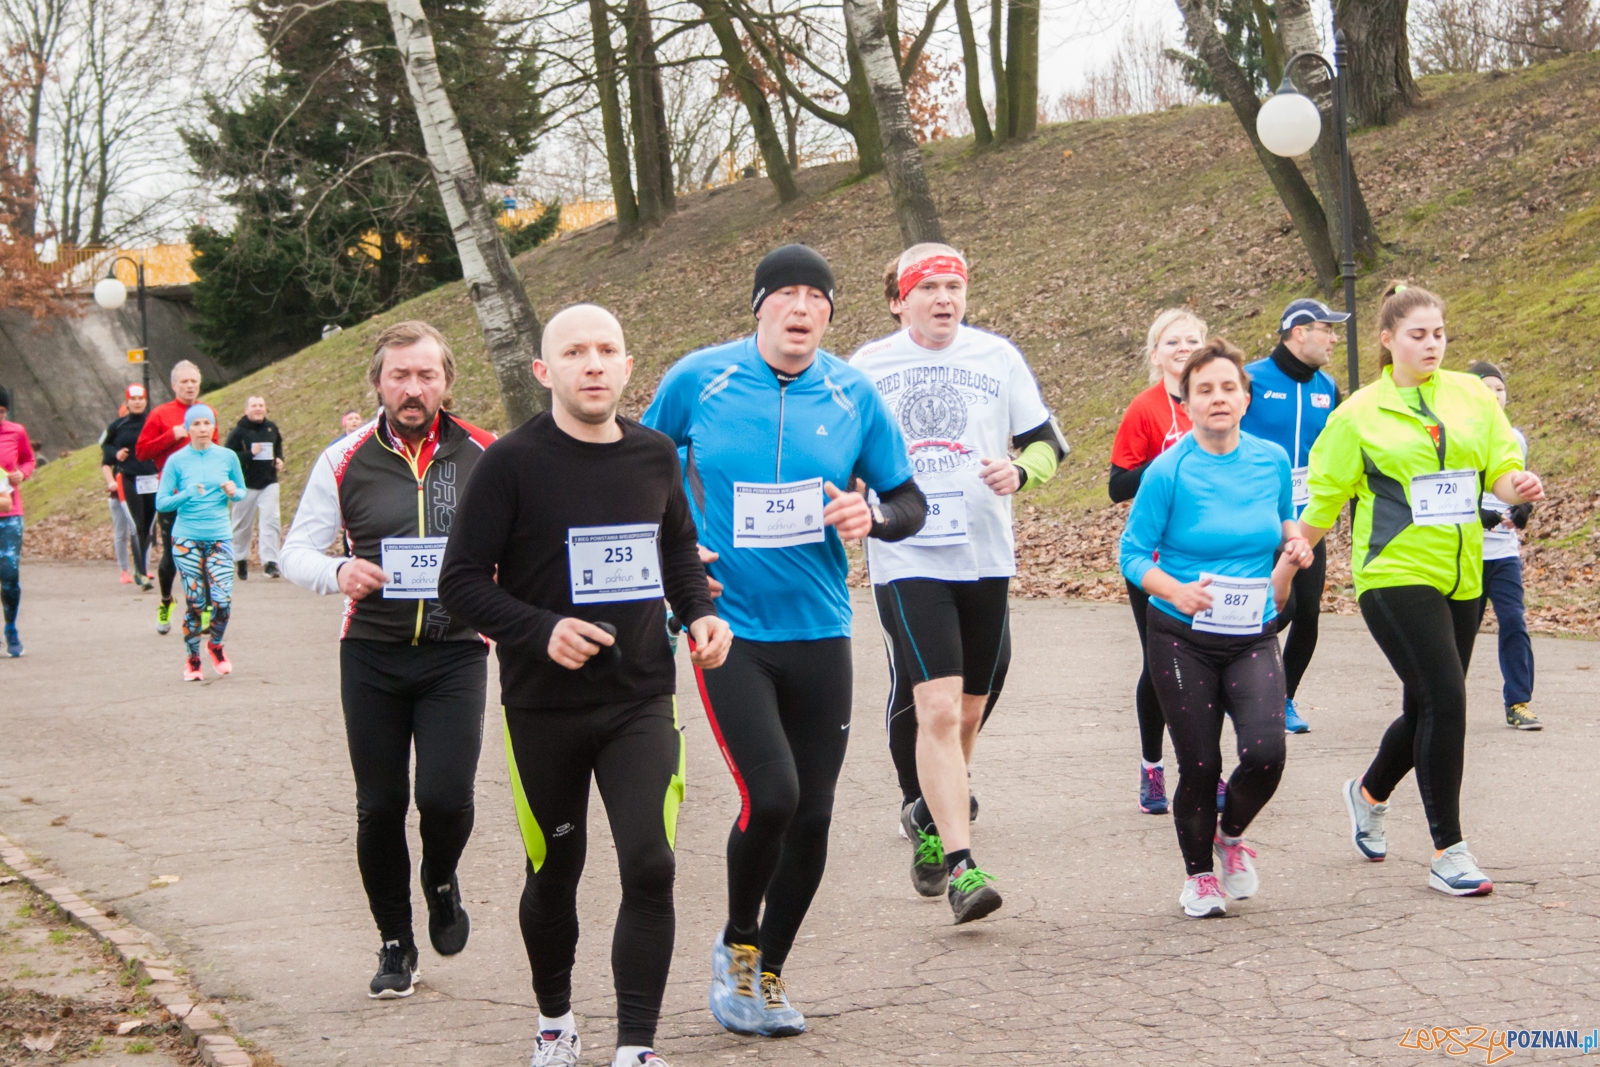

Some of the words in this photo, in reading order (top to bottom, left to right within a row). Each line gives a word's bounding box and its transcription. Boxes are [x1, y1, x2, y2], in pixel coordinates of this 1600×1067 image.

[876, 372, 900, 396] BIEG
[903, 366, 1001, 398] NIEPODLEGŁOŚCI
[1292, 479, 1302, 487] 09
[1436, 483, 1458, 495] 720
[766, 499, 795, 513] 254
[590, 534, 618, 542] POWSTANIA
[604, 546, 633, 563] 253
[411, 555, 438, 568] 255
[1224, 593, 1249, 606] 887
